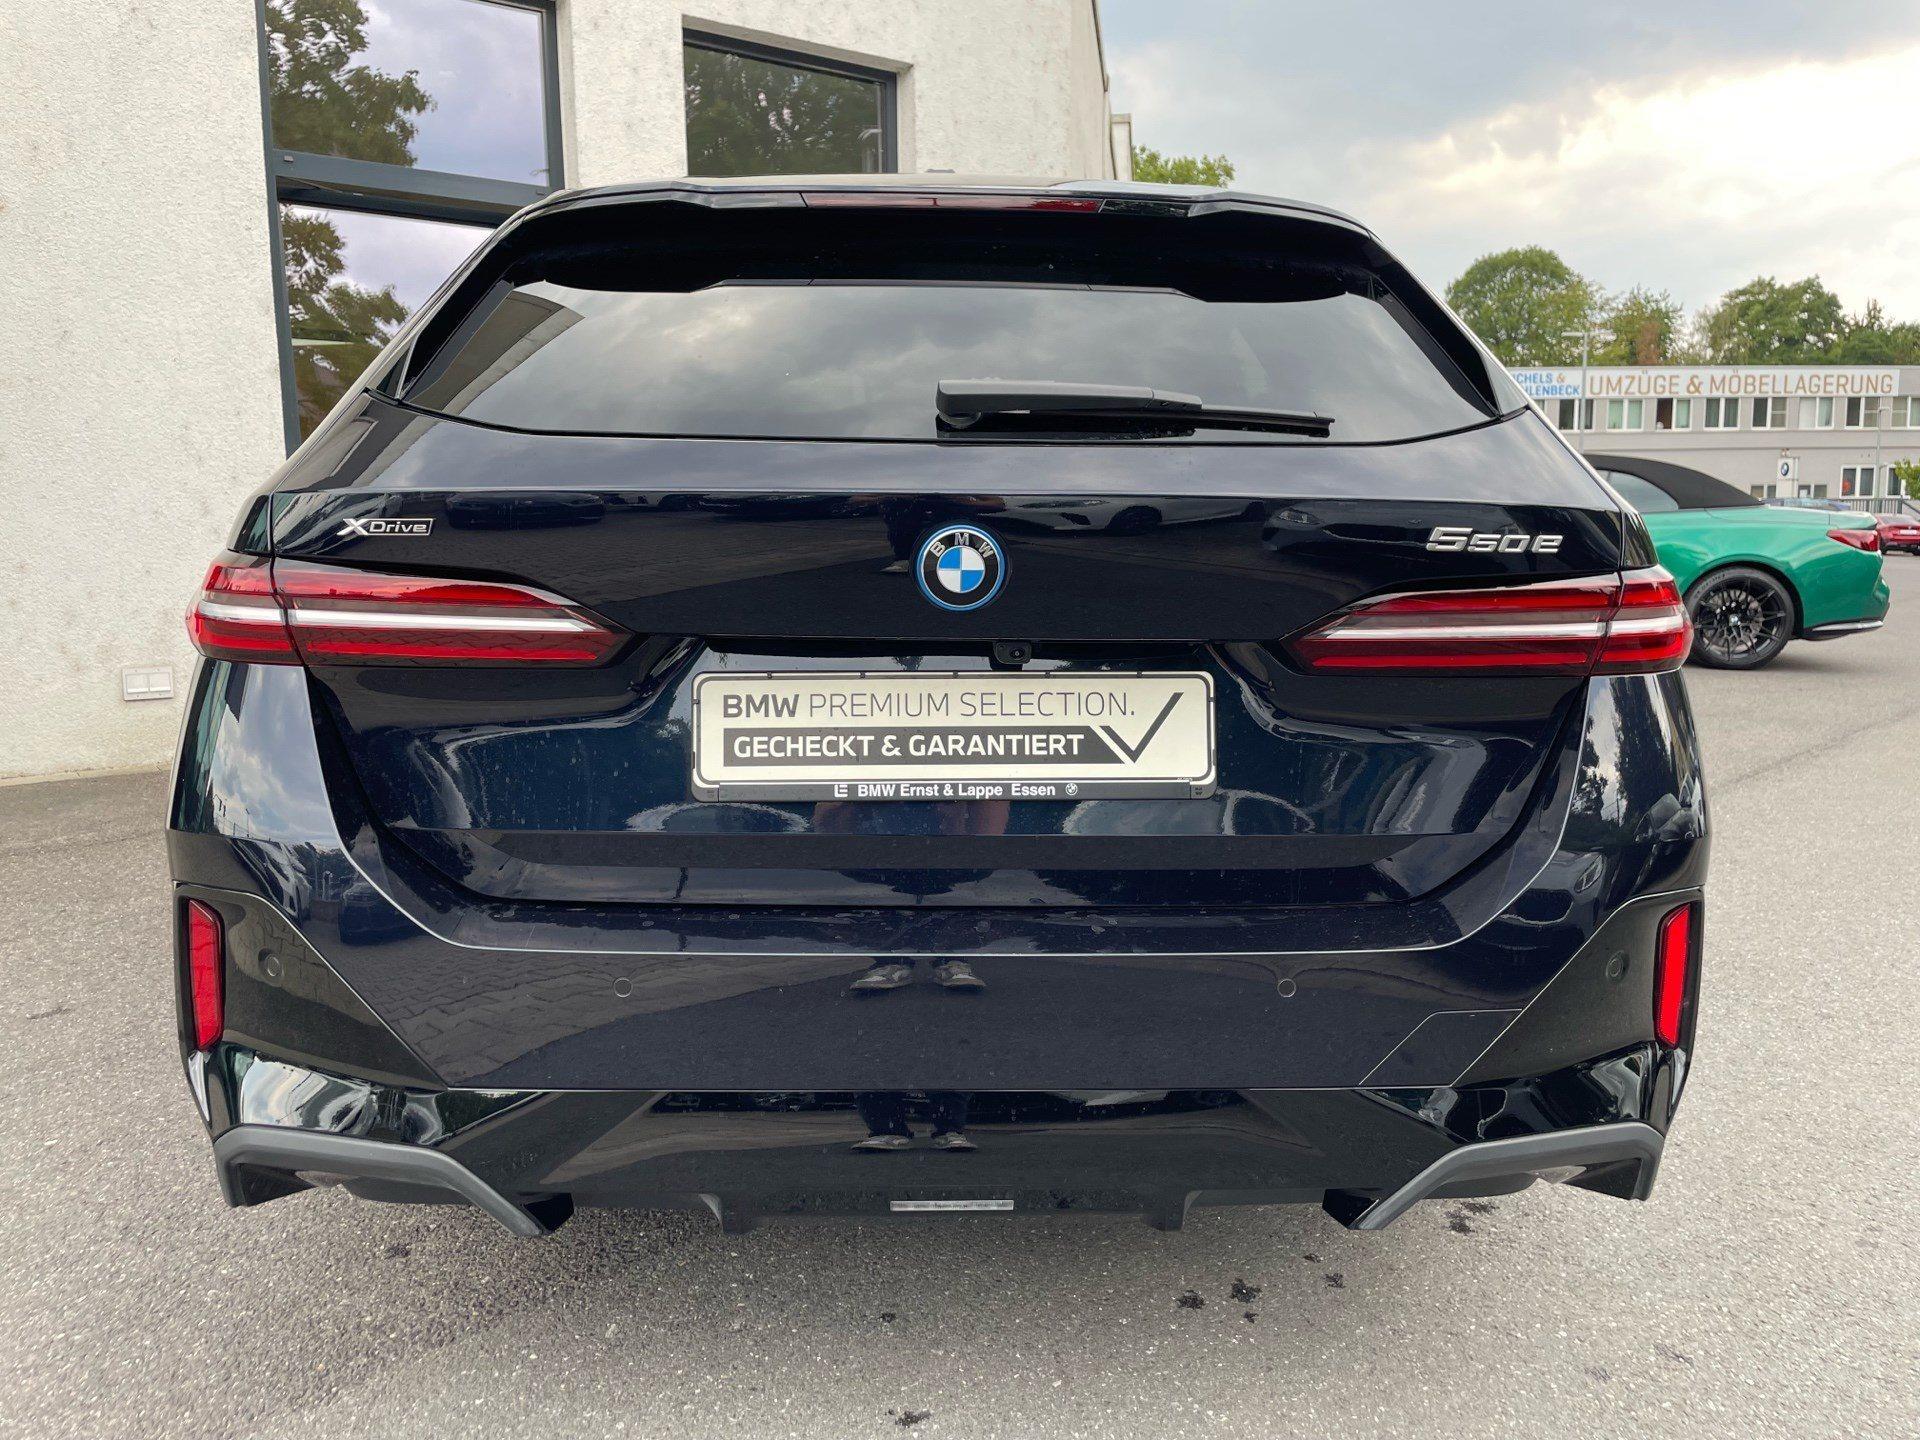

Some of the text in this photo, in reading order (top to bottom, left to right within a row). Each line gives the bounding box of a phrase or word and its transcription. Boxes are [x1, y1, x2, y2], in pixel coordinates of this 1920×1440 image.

[1556, 373, 1566, 383] &
[1589, 369, 1893, 396] UMZÜGE & MÖBELLAGERUNG
[929, 532, 994, 558] BMW
[723, 691, 1135, 718] BMW PREMIUM SELECTION.
[733, 734, 1085, 758] GECHECKT & GARANTIERT
[857, 784, 896, 797] BMW
[900, 784, 940, 797] Ernst
[943, 783, 954, 797] &
[958, 783, 1003, 799] Lappe
[1011, 783, 1056, 796] Essen
